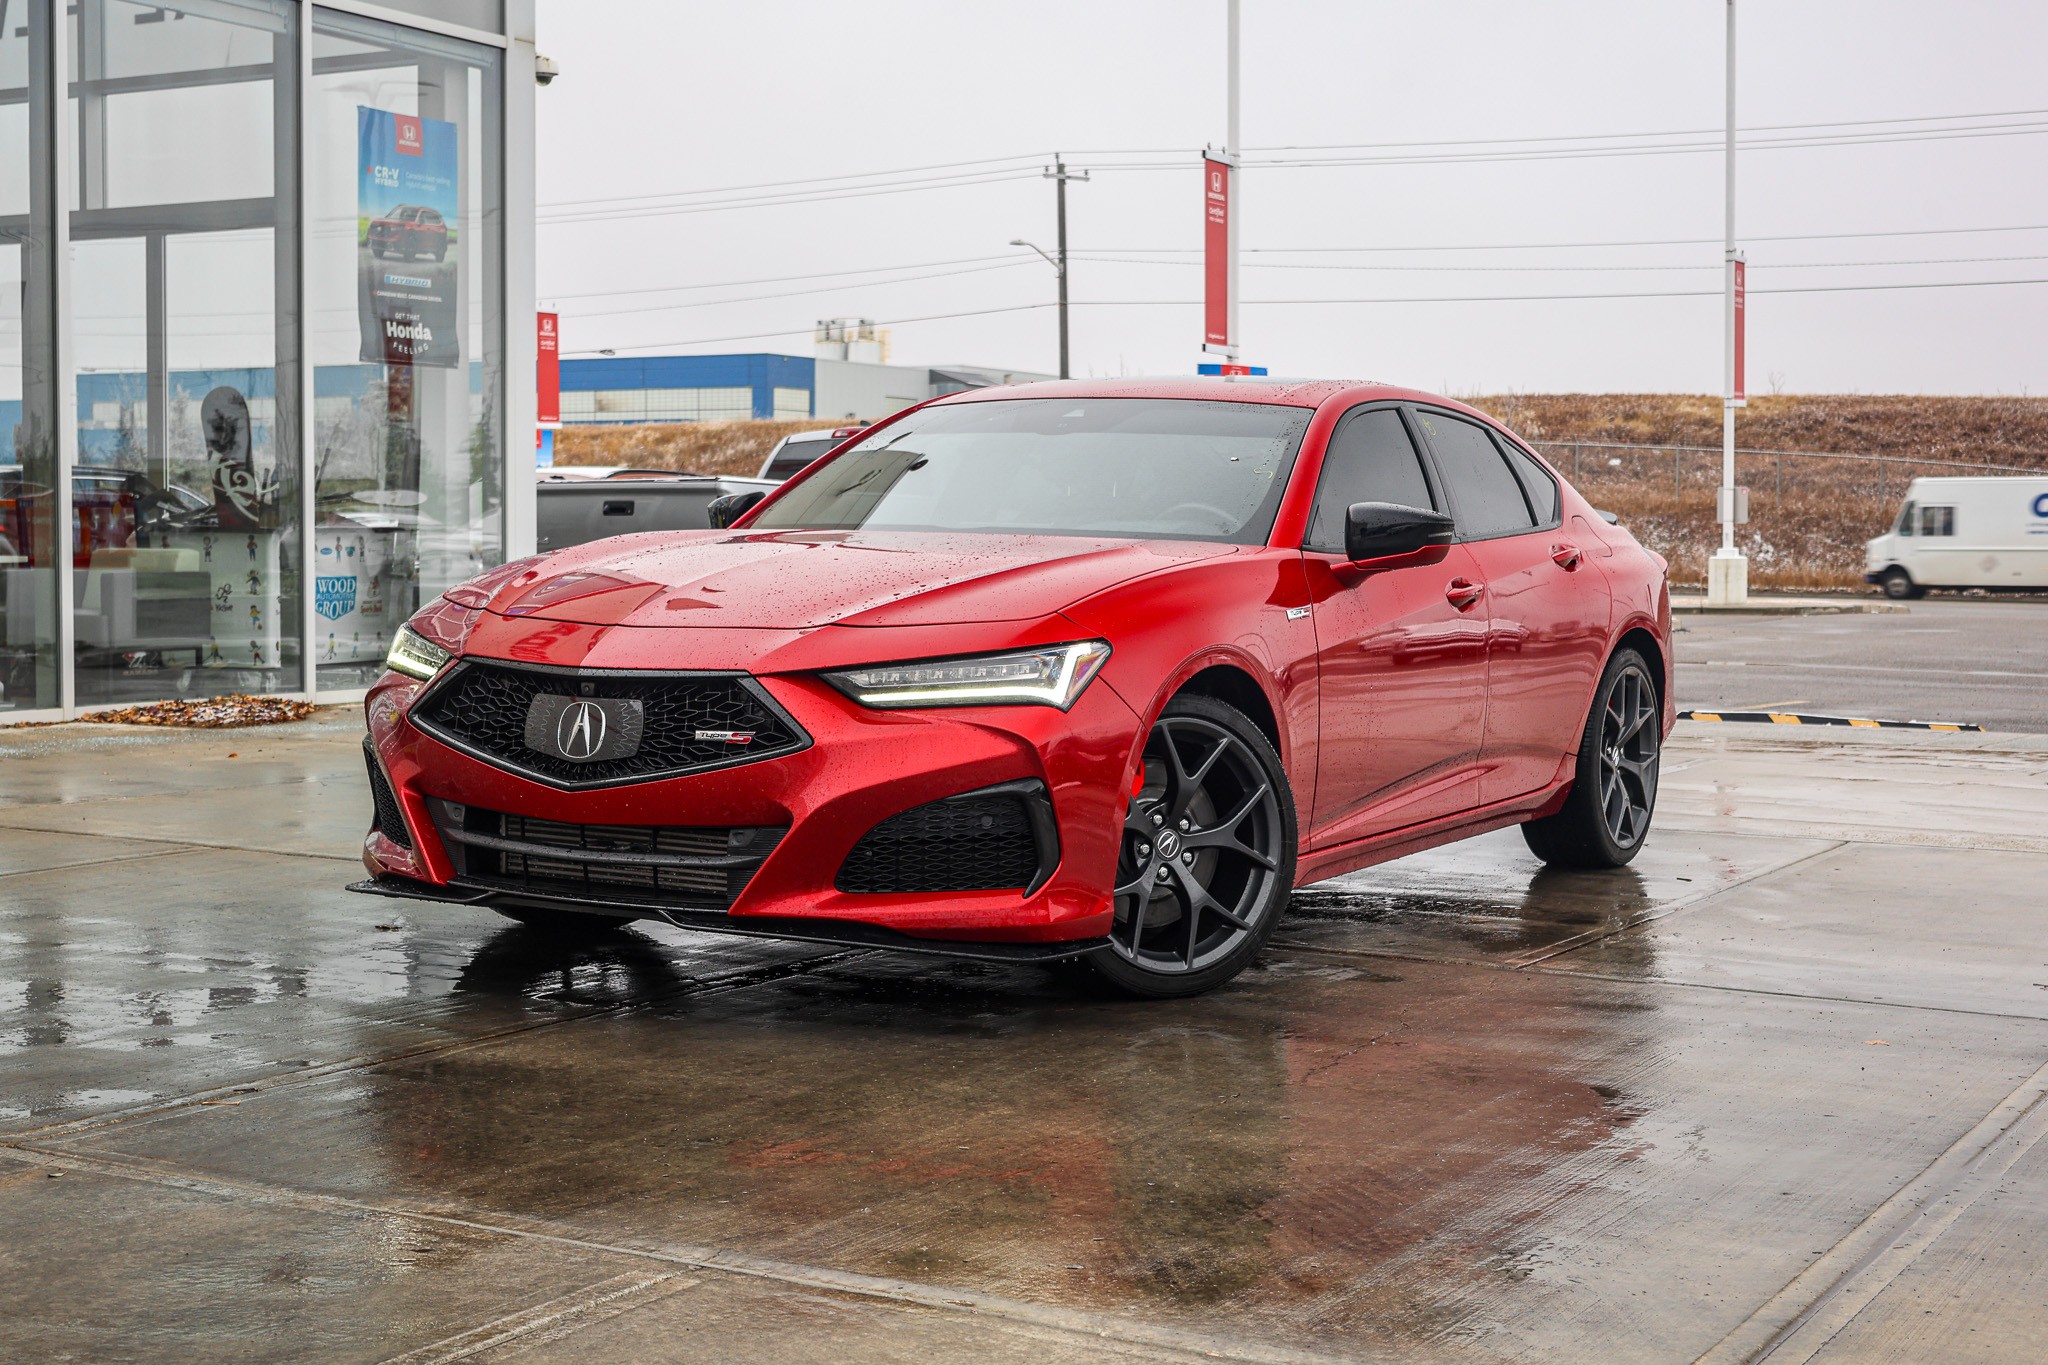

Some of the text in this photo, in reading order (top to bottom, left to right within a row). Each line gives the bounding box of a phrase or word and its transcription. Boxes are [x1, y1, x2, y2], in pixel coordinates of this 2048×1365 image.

[375, 165, 399, 180] CR-V
[375, 178, 399, 187] HYBRID
[391, 276, 429, 288] HYBRID
[386, 320, 432, 341] Honda
[393, 341, 429, 355] FEELING
[317, 578, 356, 594] WOOD
[315, 601, 354, 619] GROUP
[725, 731, 755, 744] S
